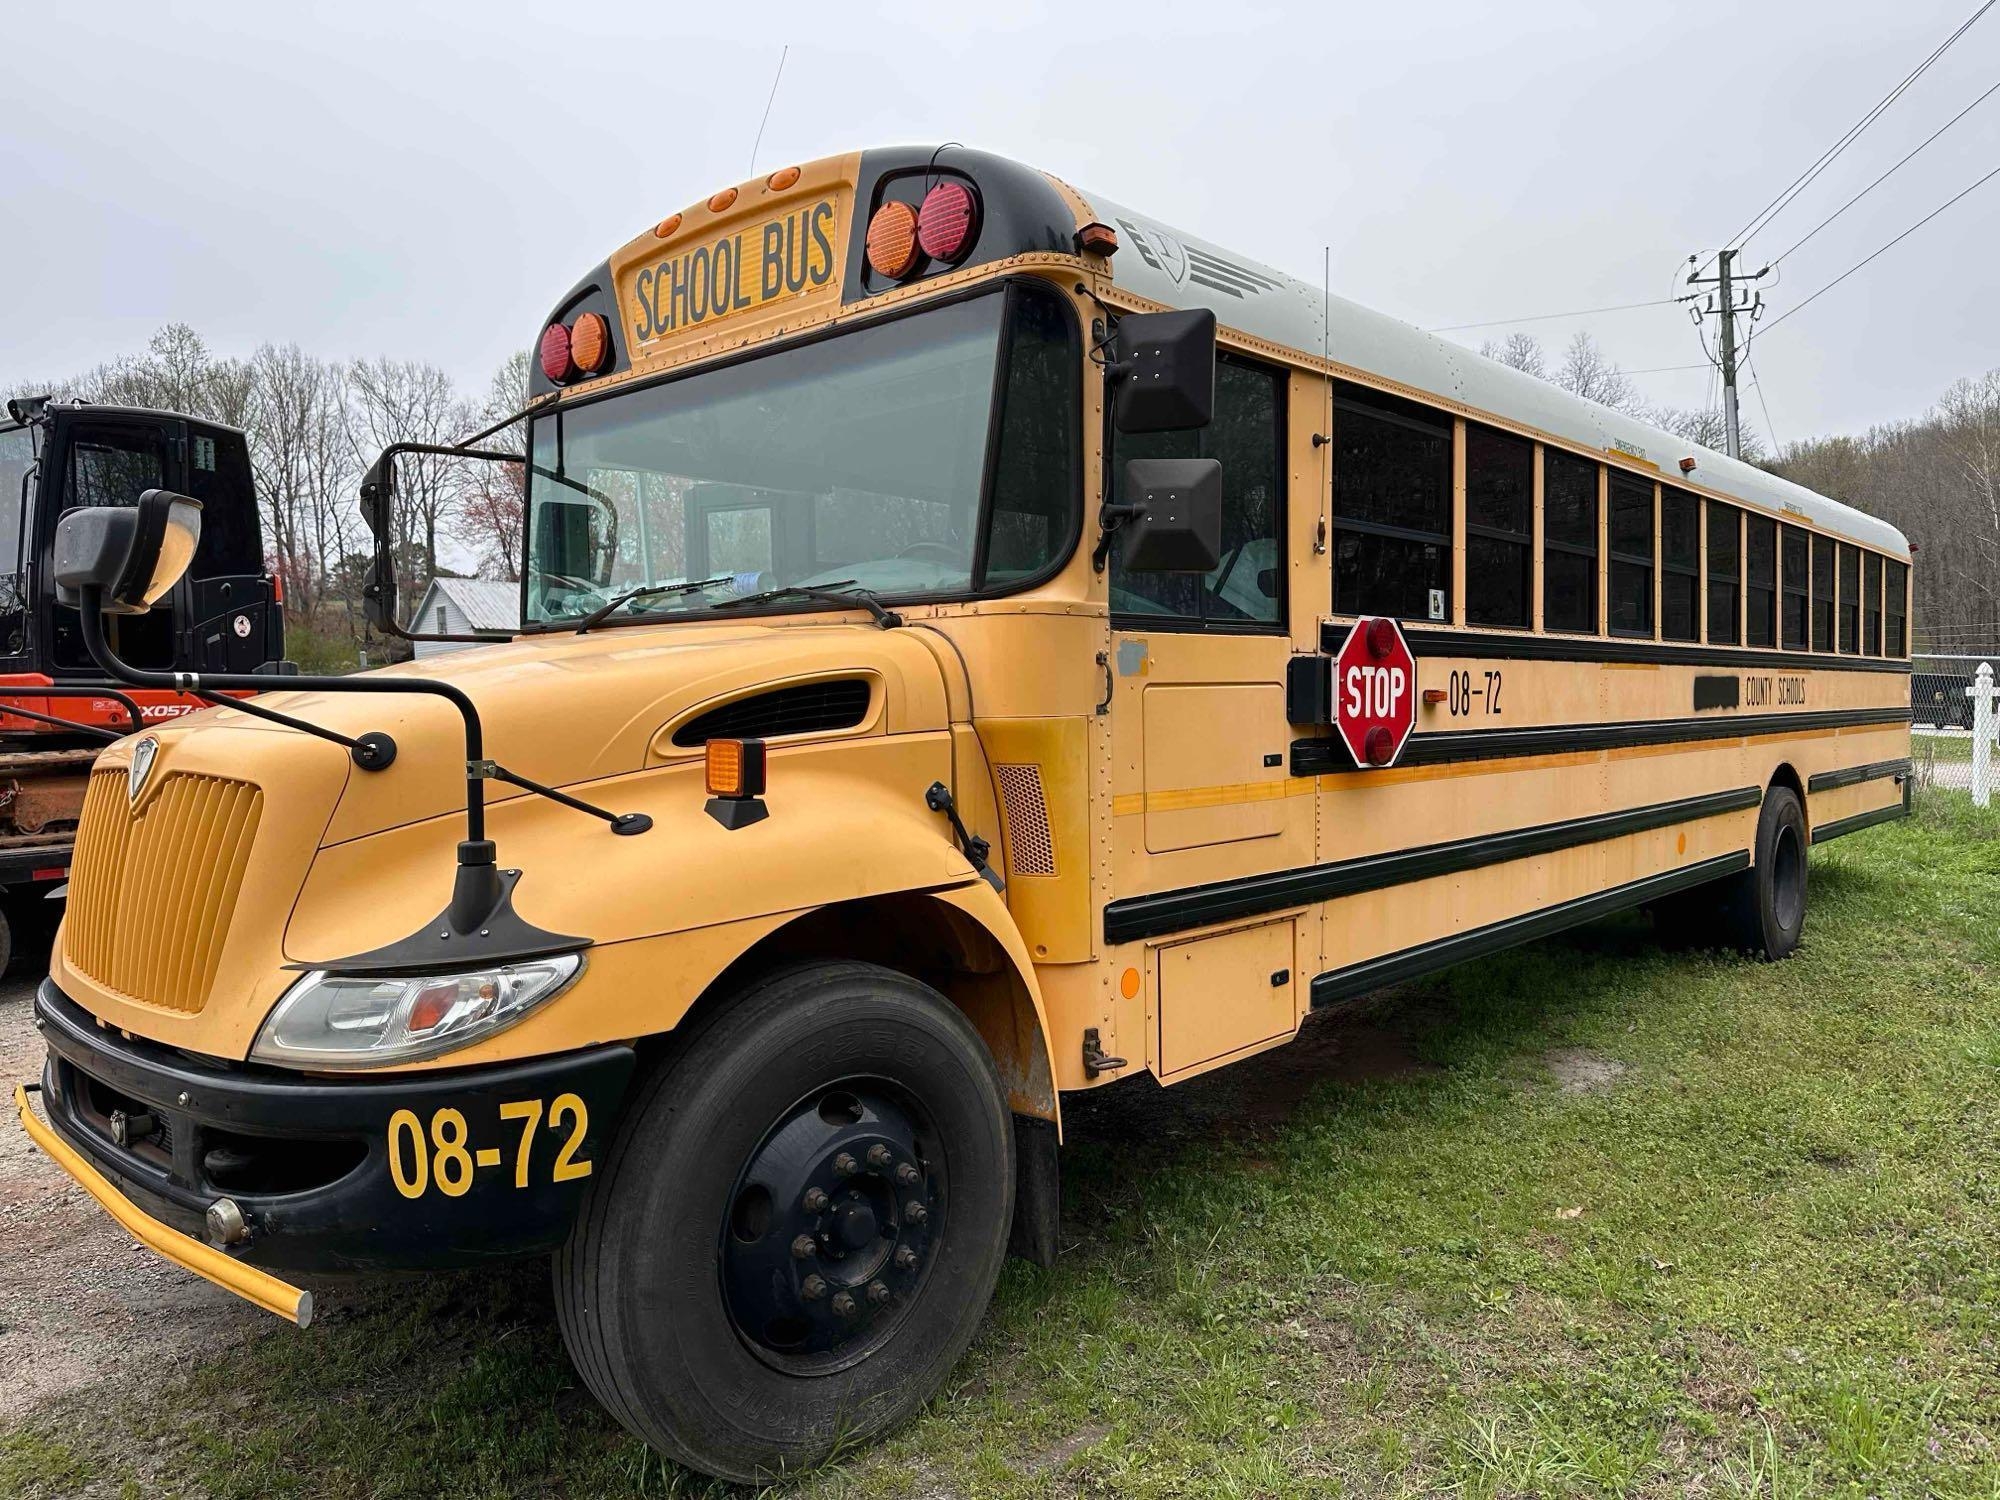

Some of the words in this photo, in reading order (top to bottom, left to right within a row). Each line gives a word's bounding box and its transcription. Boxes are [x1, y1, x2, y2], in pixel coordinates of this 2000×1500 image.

[636, 235, 751, 341] SCHOOL
[761, 201, 833, 301] BUS
[1346, 665, 1405, 718] STOP
[1450, 670, 1502, 716] 08-72
[1746, 676, 1773, 706] COUNTY
[1778, 677, 1806, 705] SCHOOLS
[388, 1093, 593, 1199] 08-72
